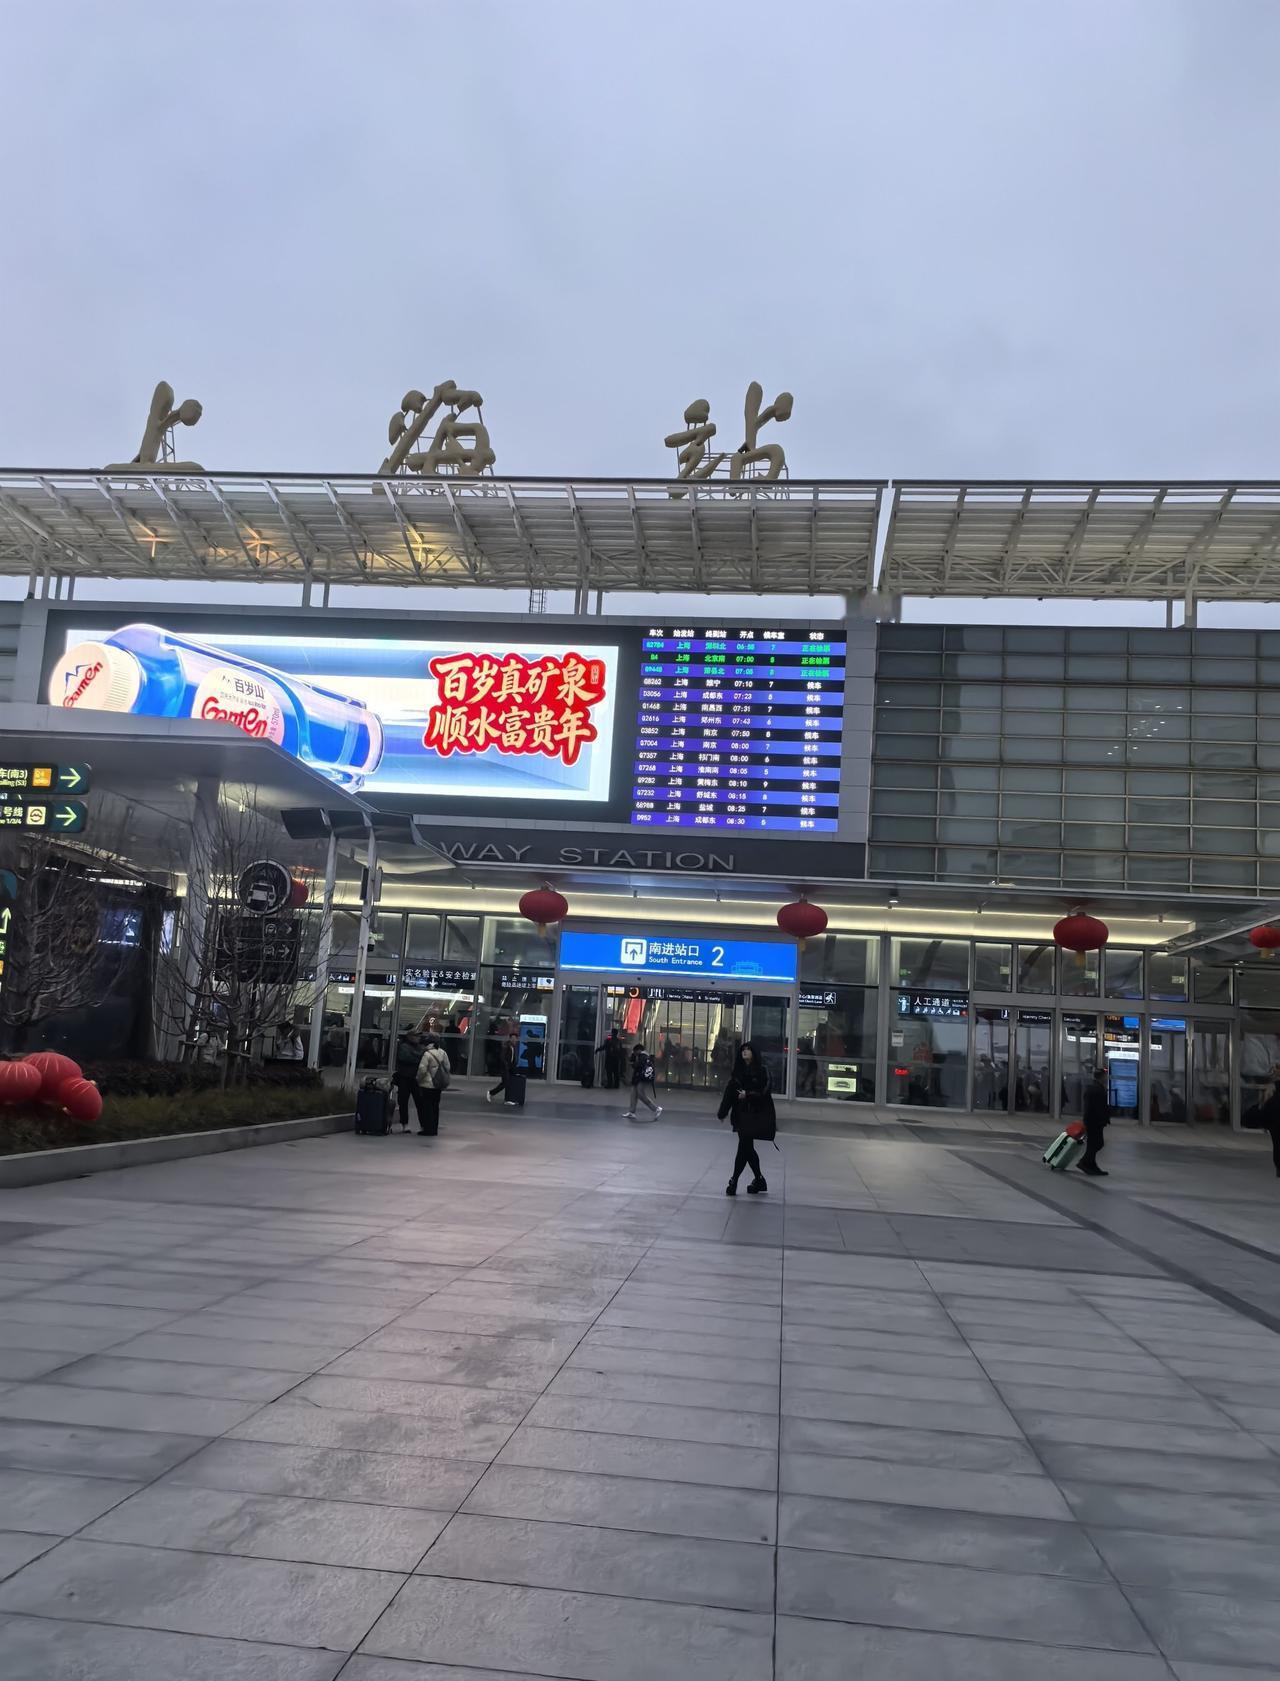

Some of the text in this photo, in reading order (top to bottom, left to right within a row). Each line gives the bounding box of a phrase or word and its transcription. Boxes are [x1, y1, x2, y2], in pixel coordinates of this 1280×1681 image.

[104, 380, 794, 495] 上海站
[648, 628, 664, 638] 车次
[739, 630, 754, 639] 开点
[676, 641, 691, 650] 上海
[675, 653, 691, 663] 上海
[704, 654, 726, 663] 北京南
[735, 655, 755, 663] 07:00
[674, 665, 690, 674] 上海
[436, 657, 600, 706] 百岁真矿泉
[673, 678, 689, 687] 上海
[734, 680, 754, 688] 07:10
[806, 681, 822, 690] 候车
[234, 678, 266, 700] 百岁山
[642, 690, 662, 698] D3056
[673, 690, 688, 699] 上海
[702, 691, 723, 700] 成都东
[733, 692, 753, 700] 07:23
[806, 693, 822, 702] 候车
[672, 703, 688, 712] 上海
[732, 704, 751, 713] 07:31
[805, 706, 821, 715] 候车
[671, 715, 687, 724] 上海
[700, 716, 722, 725] 郑州东
[732, 717, 751, 726] 07:43
[804, 719, 820, 727] 候车
[430, 704, 591, 759] 顺水富贵年
[671, 727, 686, 736] 上海
[703, 728, 719, 737] 南京
[731, 729, 751, 738] 07:50
[803, 731, 820, 740] 候车
[670, 740, 685, 749] 上海
[702, 740, 718, 750] 南京
[730, 742, 750, 750] 08:00
[803, 744, 819, 753] 候车
[669, 752, 685, 761] 上海
[729, 754, 749, 763] 08:00
[802, 756, 819, 766] 候车
[669, 764, 684, 773] 上海
[729, 767, 748, 775] 08:05
[802, 769, 818, 778] 候车
[667, 777, 683, 786] 上海
[728, 779, 748, 788] 08:10
[801, 781, 817, 791] 候车
[667, 790, 682, 798] 上海
[801, 794, 816, 803] 候车
[666, 802, 681, 811] 上海
[726, 804, 746, 813] 08:25
[800, 806, 816, 816] 候车
[665, 815, 680, 823] 上海
[726, 817, 746, 825] 08:30
[799, 820, 815, 828] 候车
[440, 841, 735, 871] WAY STATION
[649, 942, 725, 967] 南进站口 2
[649, 956, 703, 967] South Entrance
[914, 996, 951, 1008] 人工通道
